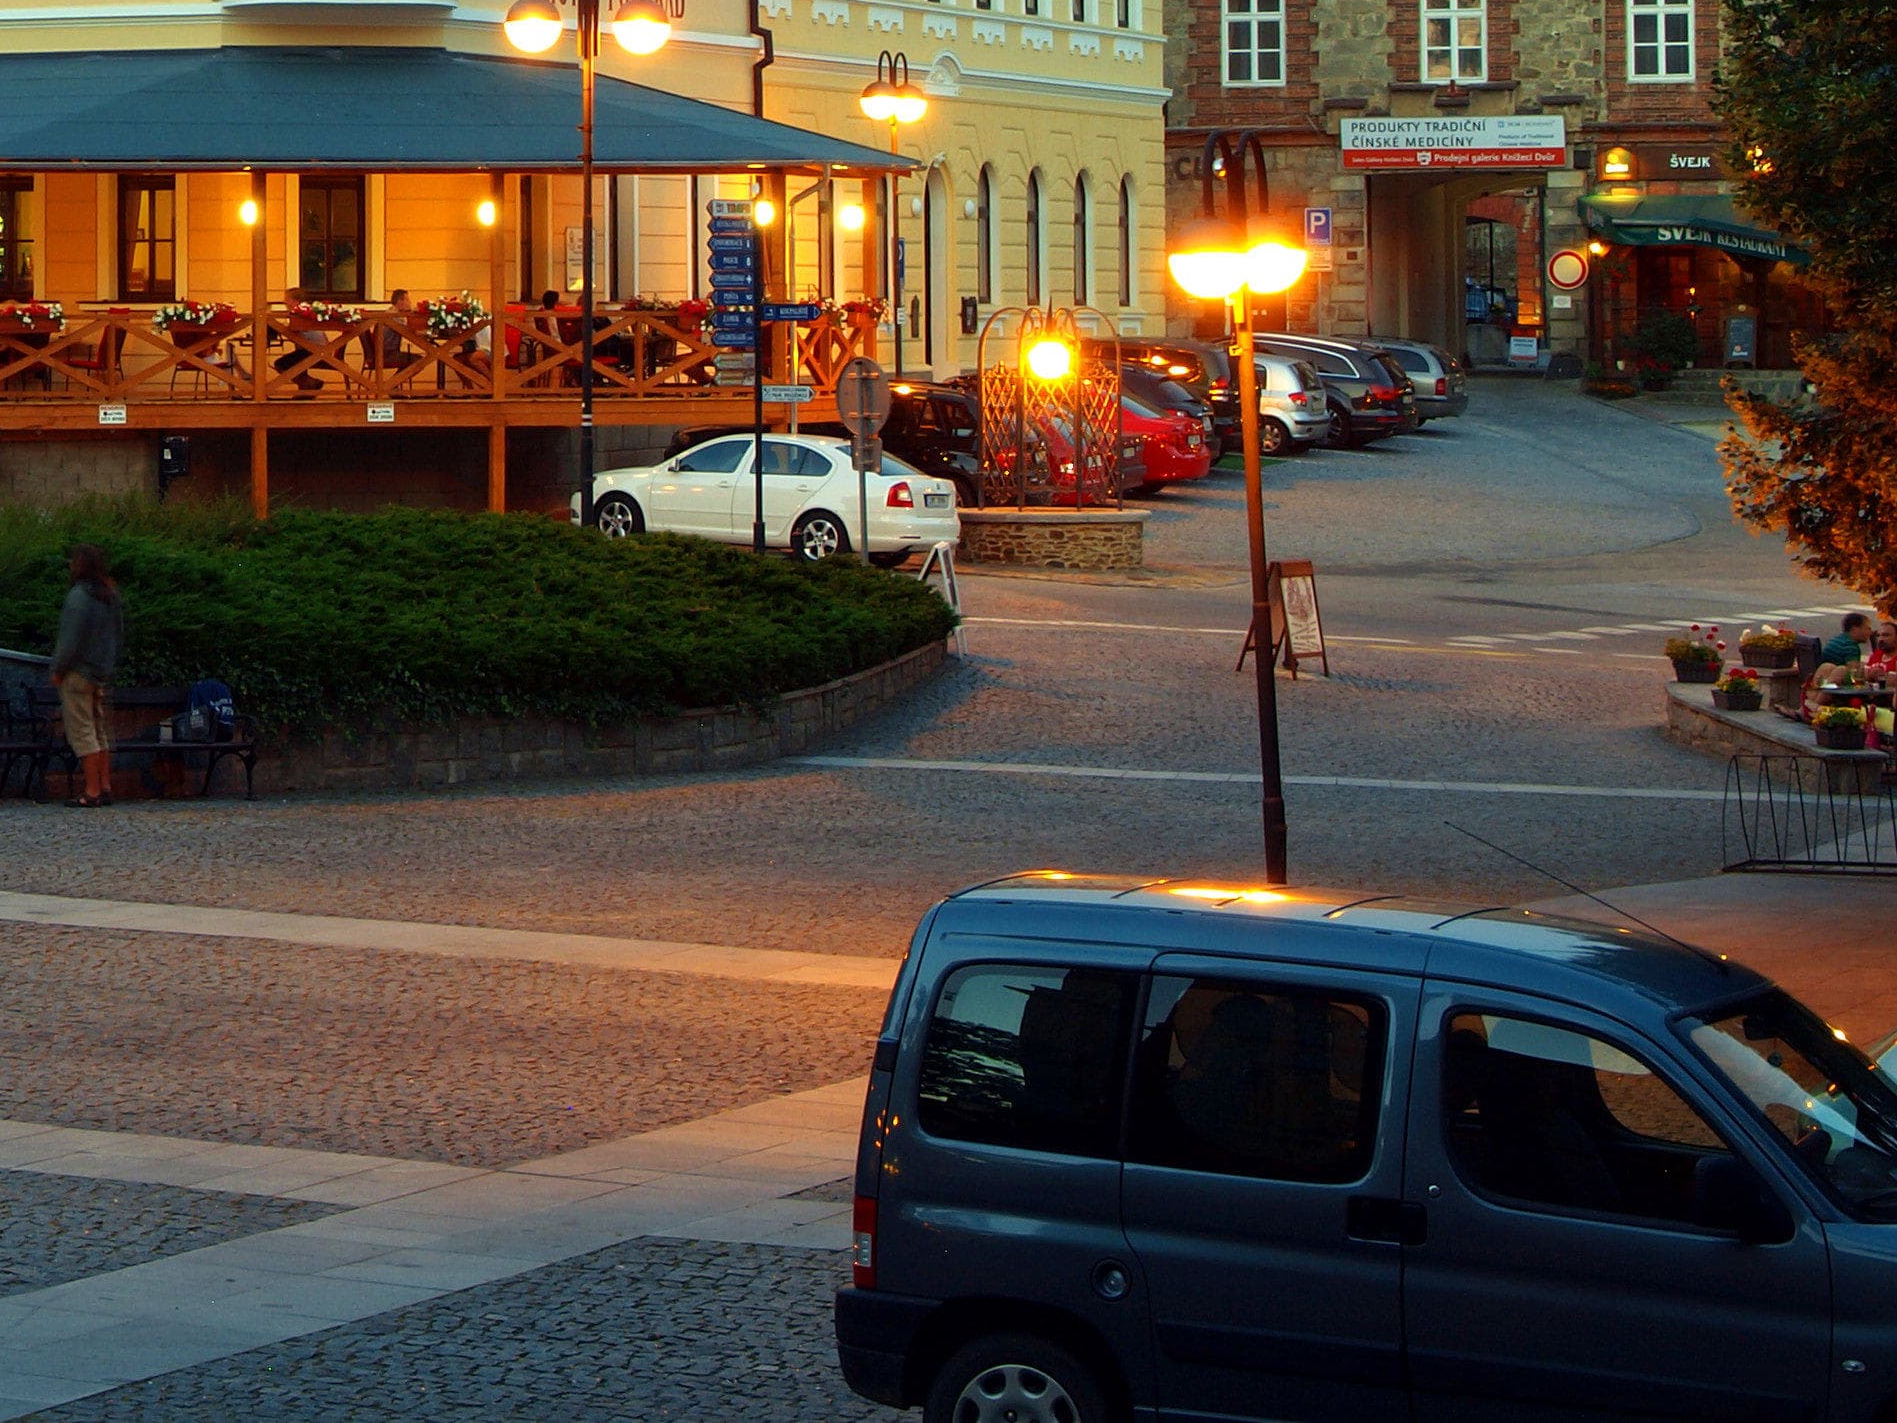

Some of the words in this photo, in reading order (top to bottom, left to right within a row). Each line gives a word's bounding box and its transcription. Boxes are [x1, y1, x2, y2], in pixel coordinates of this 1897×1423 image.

[1351, 121, 1420, 133] PRODUKTY
[1424, 119, 1486, 132] TRADIČNÍ
[1351, 136, 1399, 148] ČÍNSKÉ
[1405, 135, 1474, 148] MEDICÍNY
[1669, 154, 1711, 168] ŠVEJK
[1310, 212, 1326, 234] P
